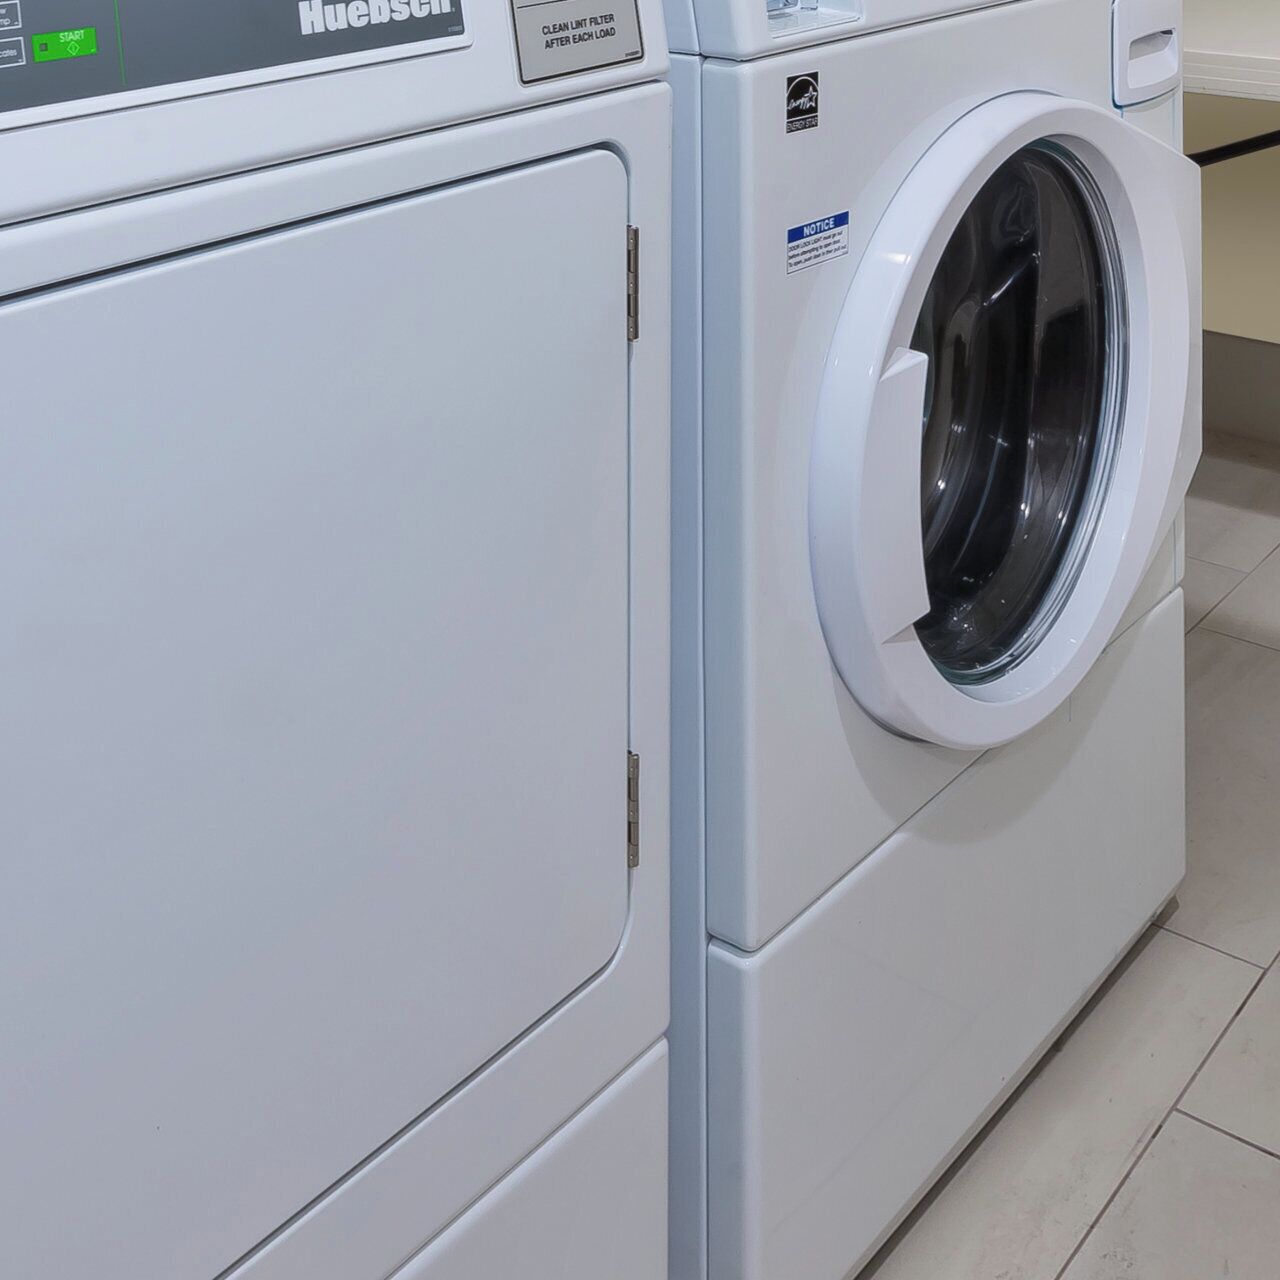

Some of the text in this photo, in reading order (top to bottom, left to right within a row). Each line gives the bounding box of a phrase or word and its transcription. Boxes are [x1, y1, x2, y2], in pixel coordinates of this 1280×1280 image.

[541, 13, 615, 35] CLEAN LINT FILTER
[59, 29, 85, 43] START
[544, 26, 616, 49] AFTER EACH LOAD
[803, 217, 835, 236] NOTICE
